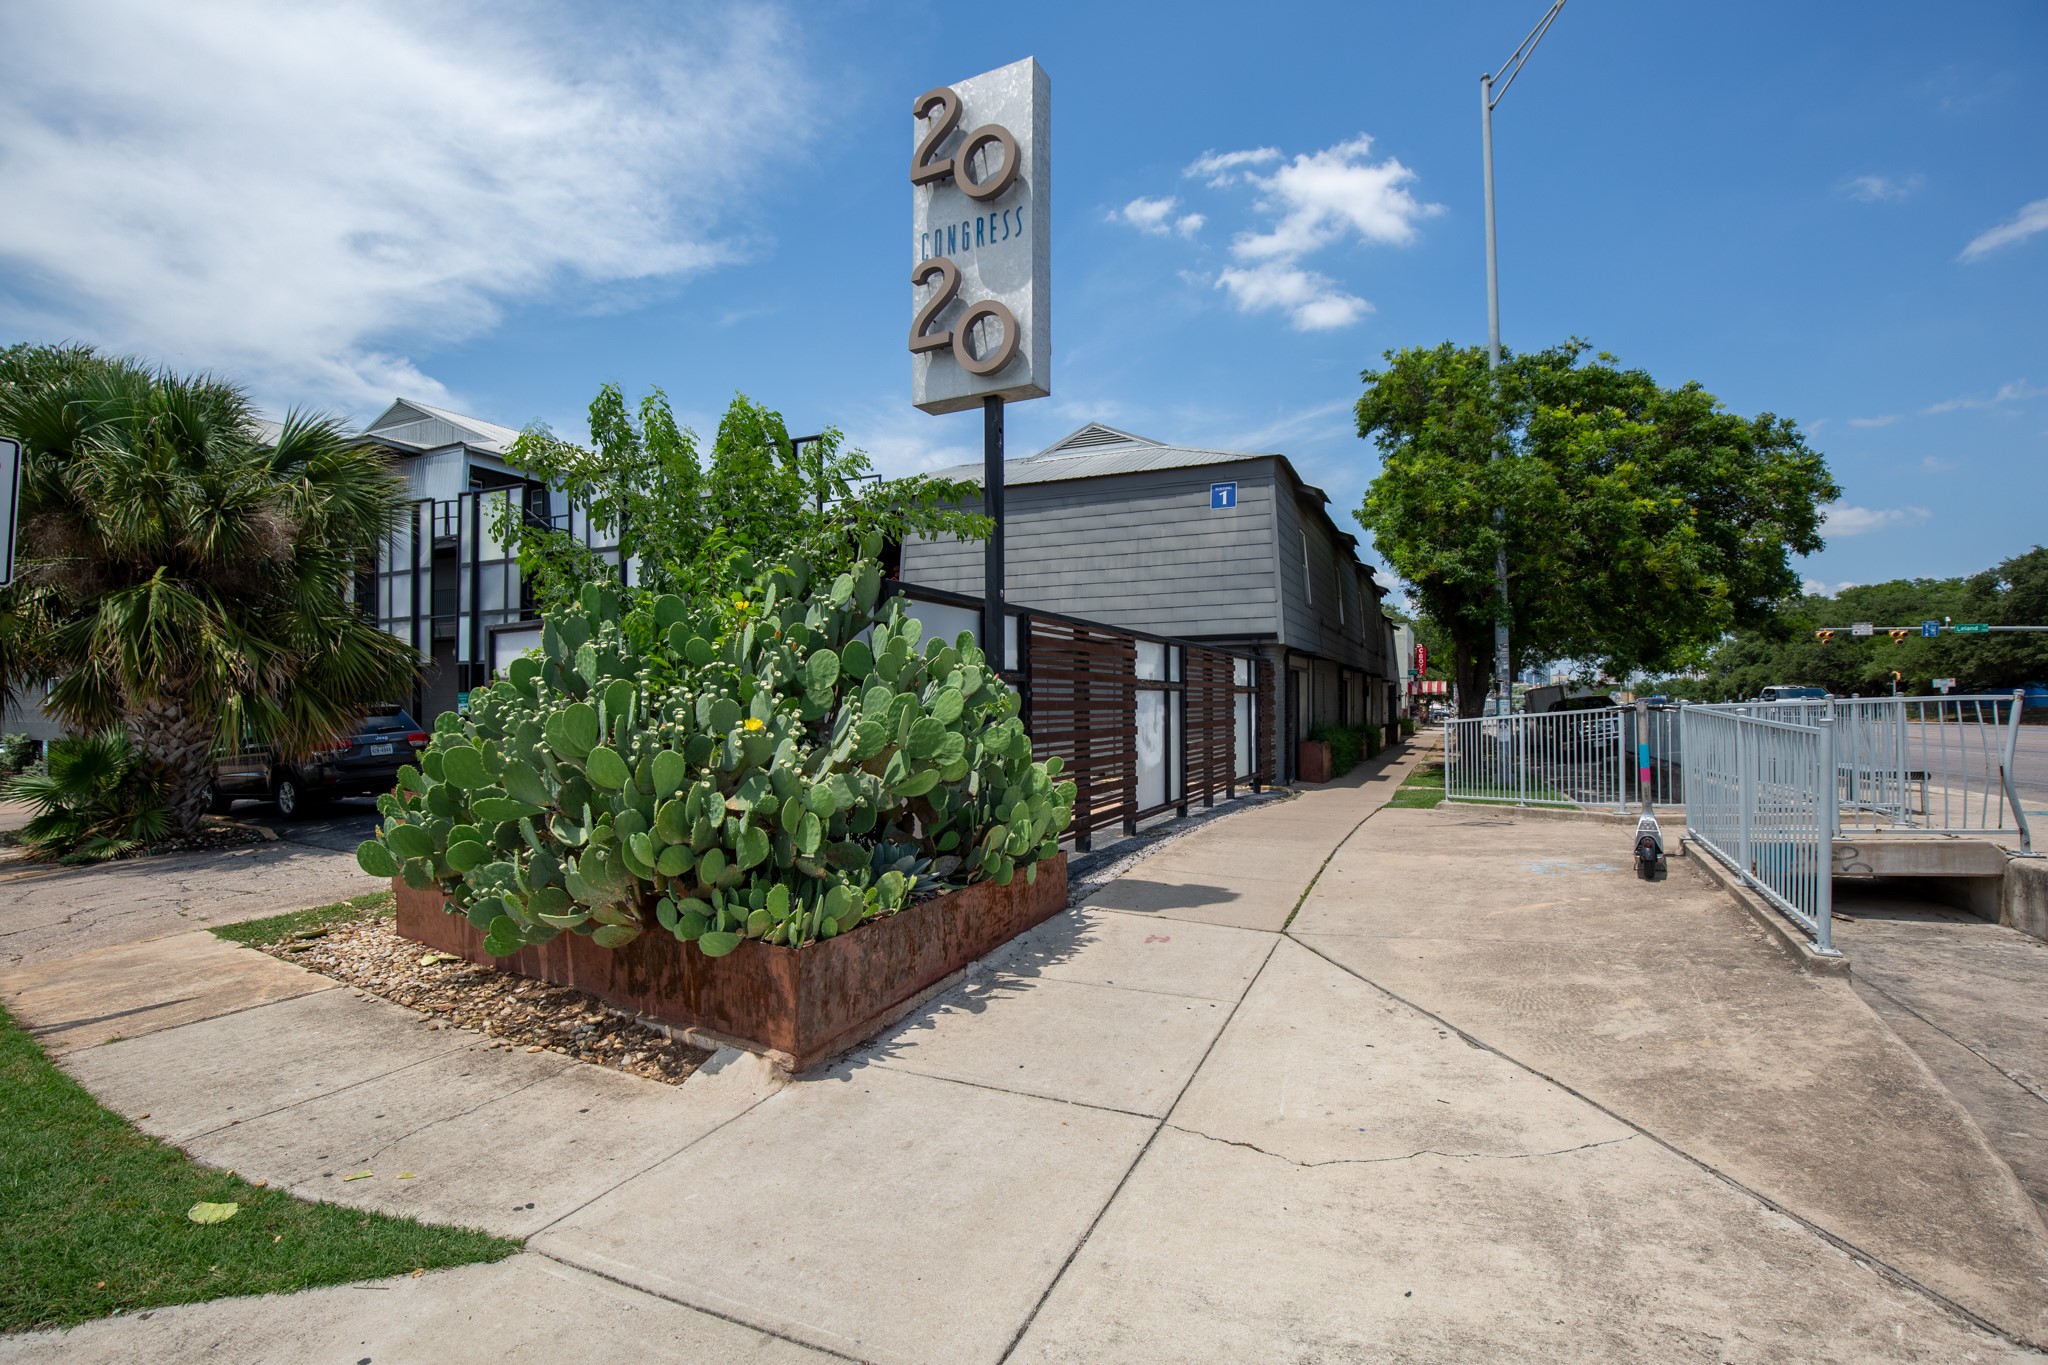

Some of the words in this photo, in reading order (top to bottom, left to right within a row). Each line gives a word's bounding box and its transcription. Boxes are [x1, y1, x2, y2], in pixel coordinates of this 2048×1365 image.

[910, 86, 1021, 202] 20
[921, 205, 1024, 261] CONGRESS
[909, 256, 1021, 376] 20
[1219, 490, 1227, 504] 1
